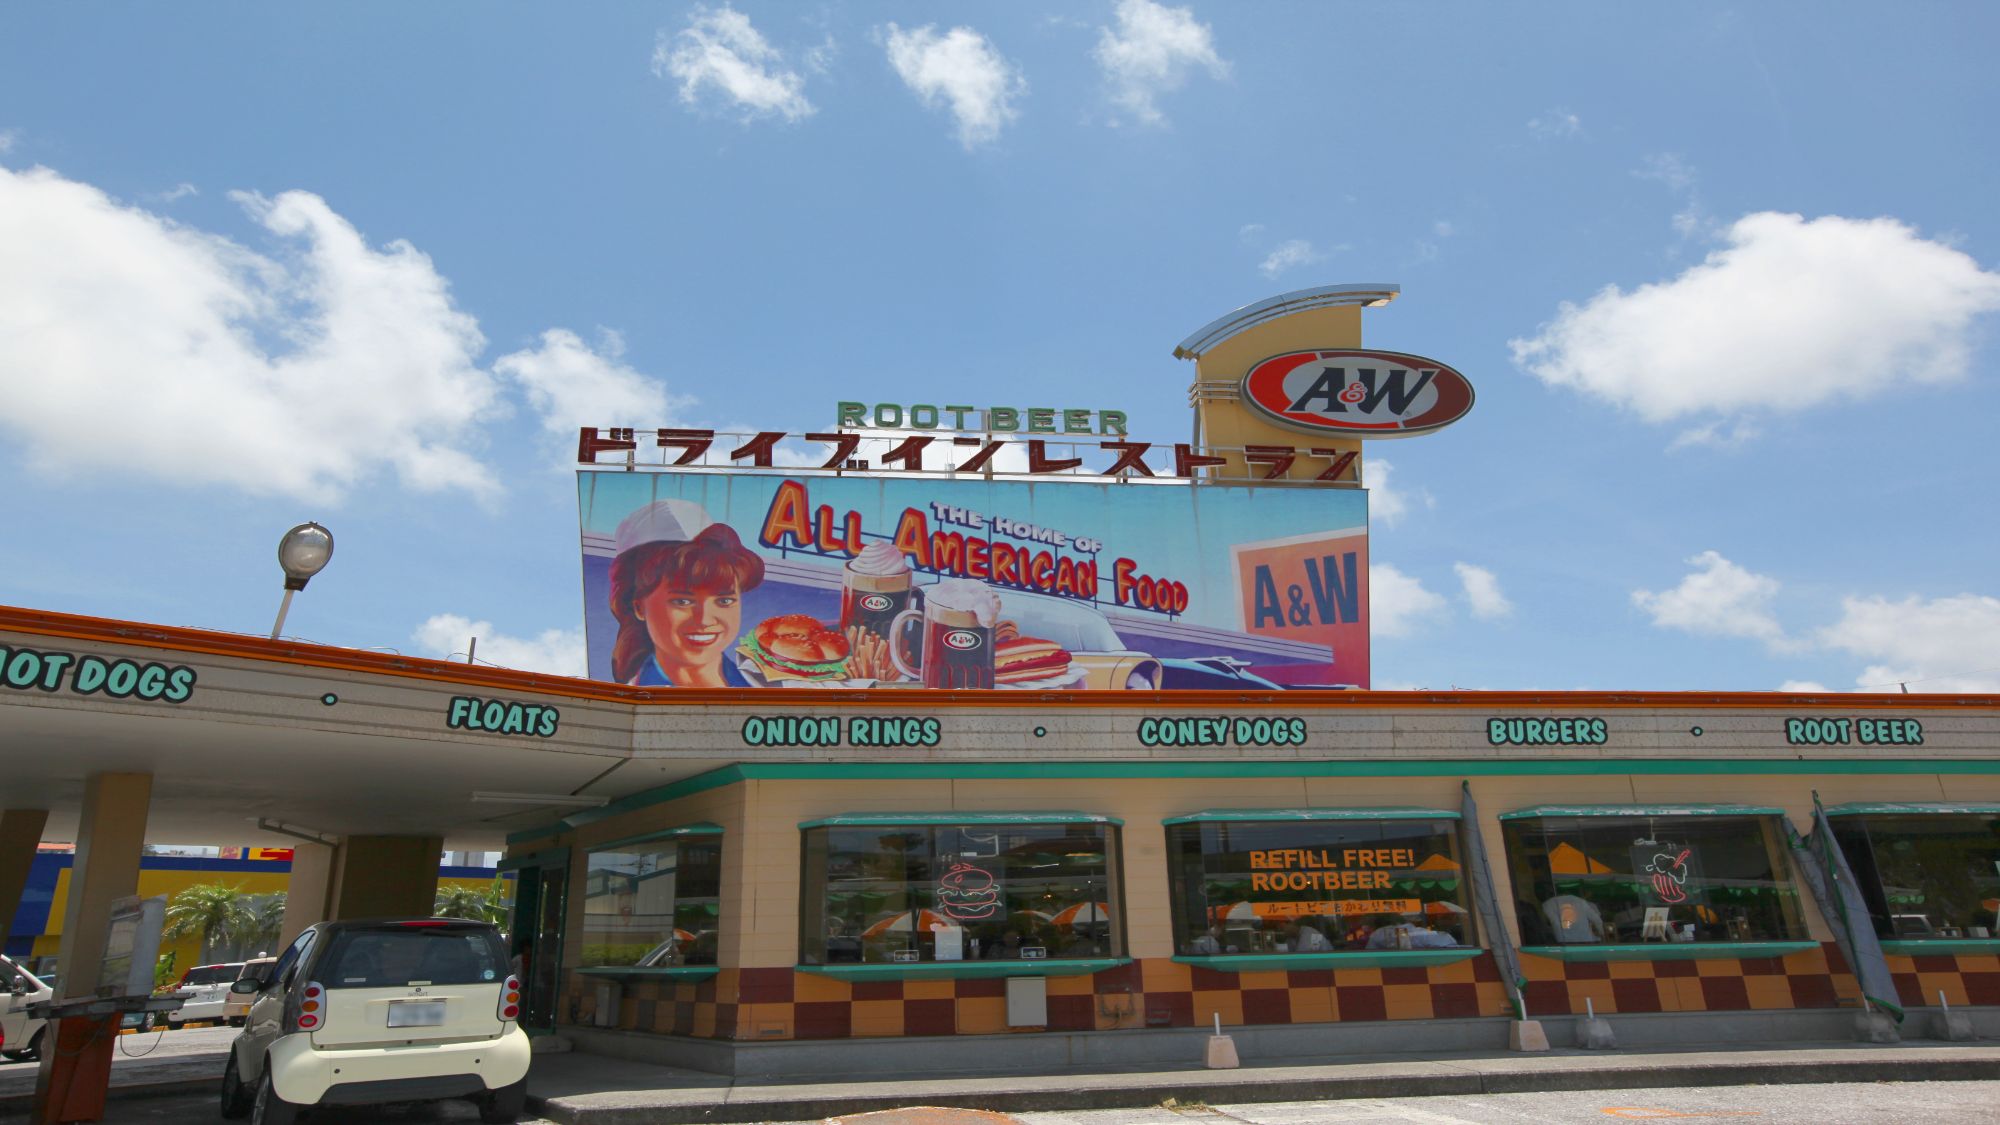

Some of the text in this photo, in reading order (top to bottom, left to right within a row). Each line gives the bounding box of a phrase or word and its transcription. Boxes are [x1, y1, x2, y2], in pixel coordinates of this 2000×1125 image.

[1286, 366, 1438, 416] A&W
[838, 401, 1128, 436] ROOT BEER
[578, 427, 1359, 482] ドライブインレストラン
[931, 501, 1102, 555] THE HOME OF
[759, 480, 1190, 615] ALL AMERICAN FOOD
[1254, 552, 1359, 629] A&W
[75, 657, 195, 701] DOGS
[448, 697, 558, 736] FLOATS
[743, 717, 940, 745] ONION RINGS
[1140, 718, 1306, 746] CONEY DOGS
[1489, 719, 1607, 744] BURGERS
[1786, 719, 1922, 744] ROOT BEER
[1250, 848, 1415, 869] REFILL FREE!
[1252, 871, 1392, 891] ROOTBEER
